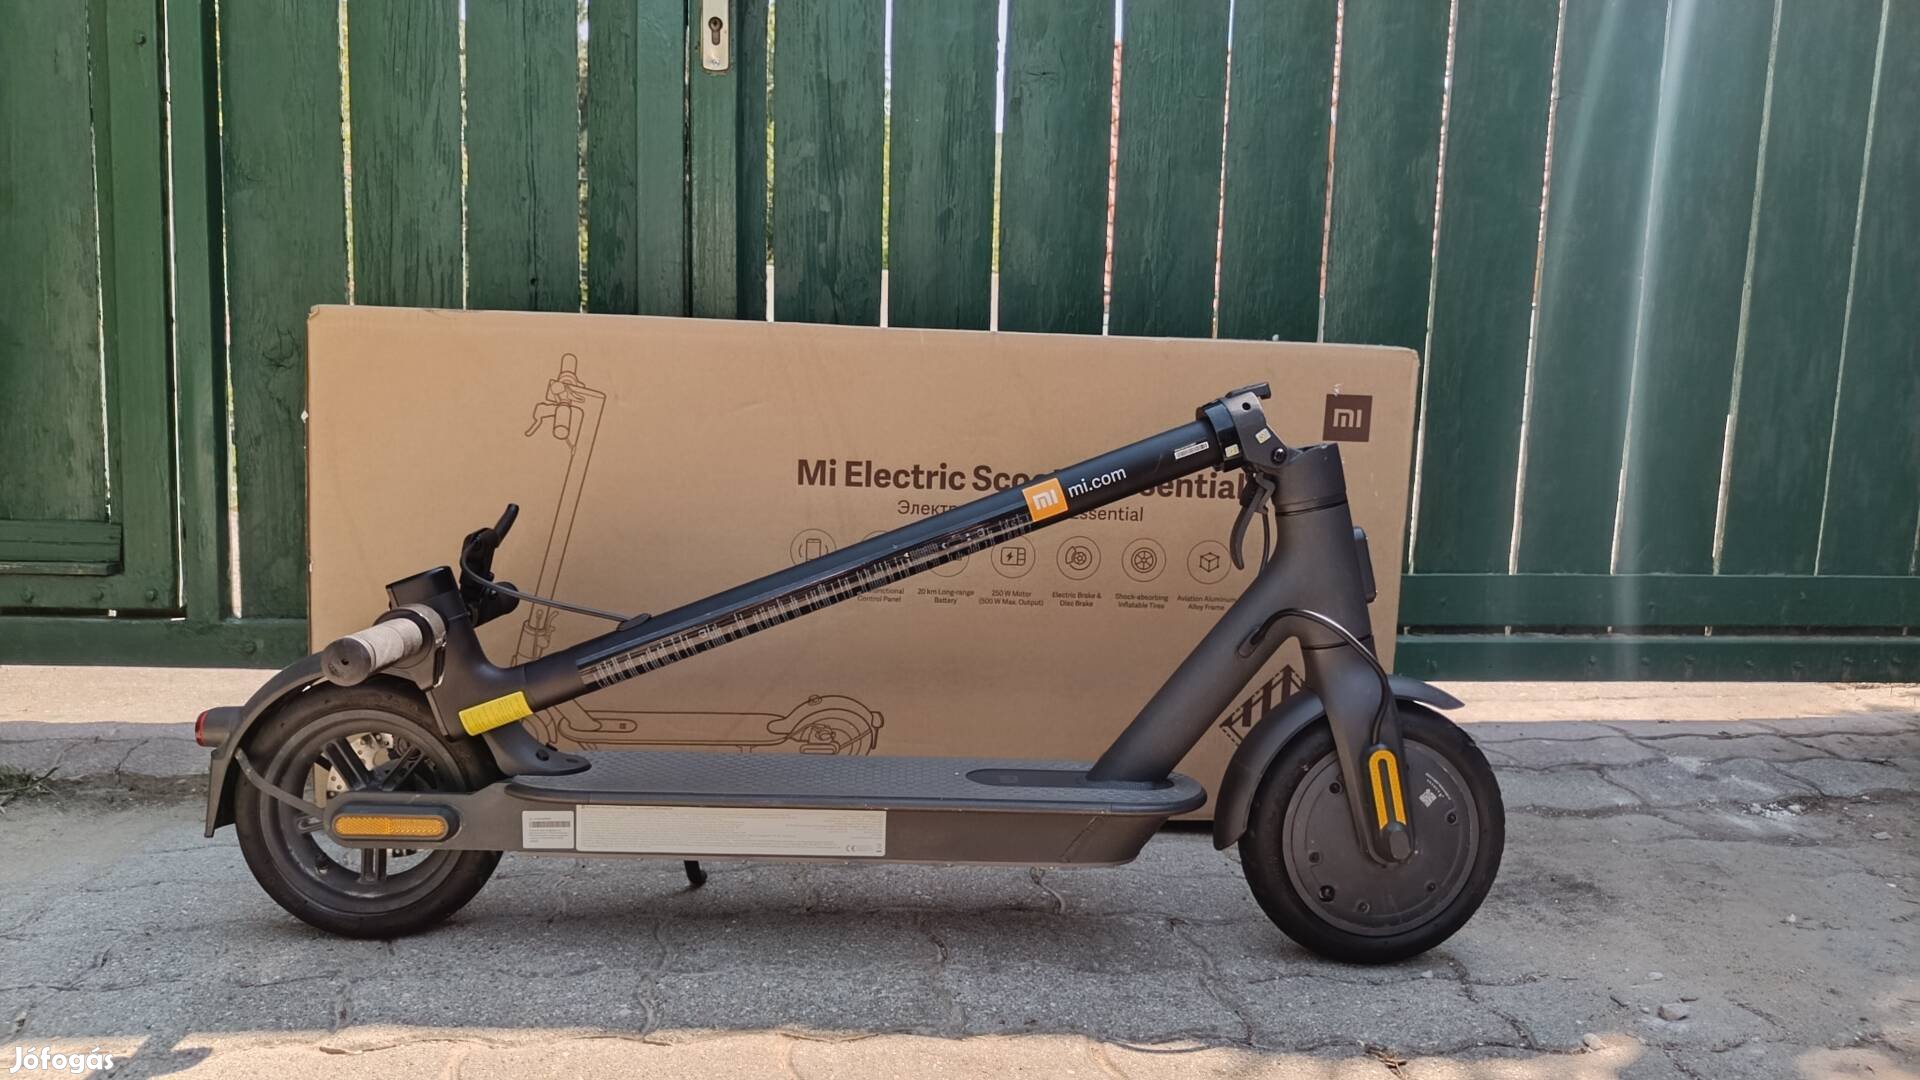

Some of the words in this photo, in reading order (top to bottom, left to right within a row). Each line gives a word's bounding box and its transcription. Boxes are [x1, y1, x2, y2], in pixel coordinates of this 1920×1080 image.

[797, 459, 836, 486] Mi
[845, 460, 966, 491] Electric
[1068, 467, 1127, 498] mi.com
[938, 588, 975, 597] Long-range
[991, 589, 1004, 597] 250
[1012, 590, 1032, 598] Motor
[1052, 591, 1077, 599] Electric
[934, 596, 958, 605] Battery
[1115, 593, 1169, 602] Shock-absorbing
[1059, 599, 1074, 607] Disc
[1118, 601, 1148, 609] Inflatable
[1188, 603, 1204, 611] Alloy
[1205, 603, 1225, 611] Frame
